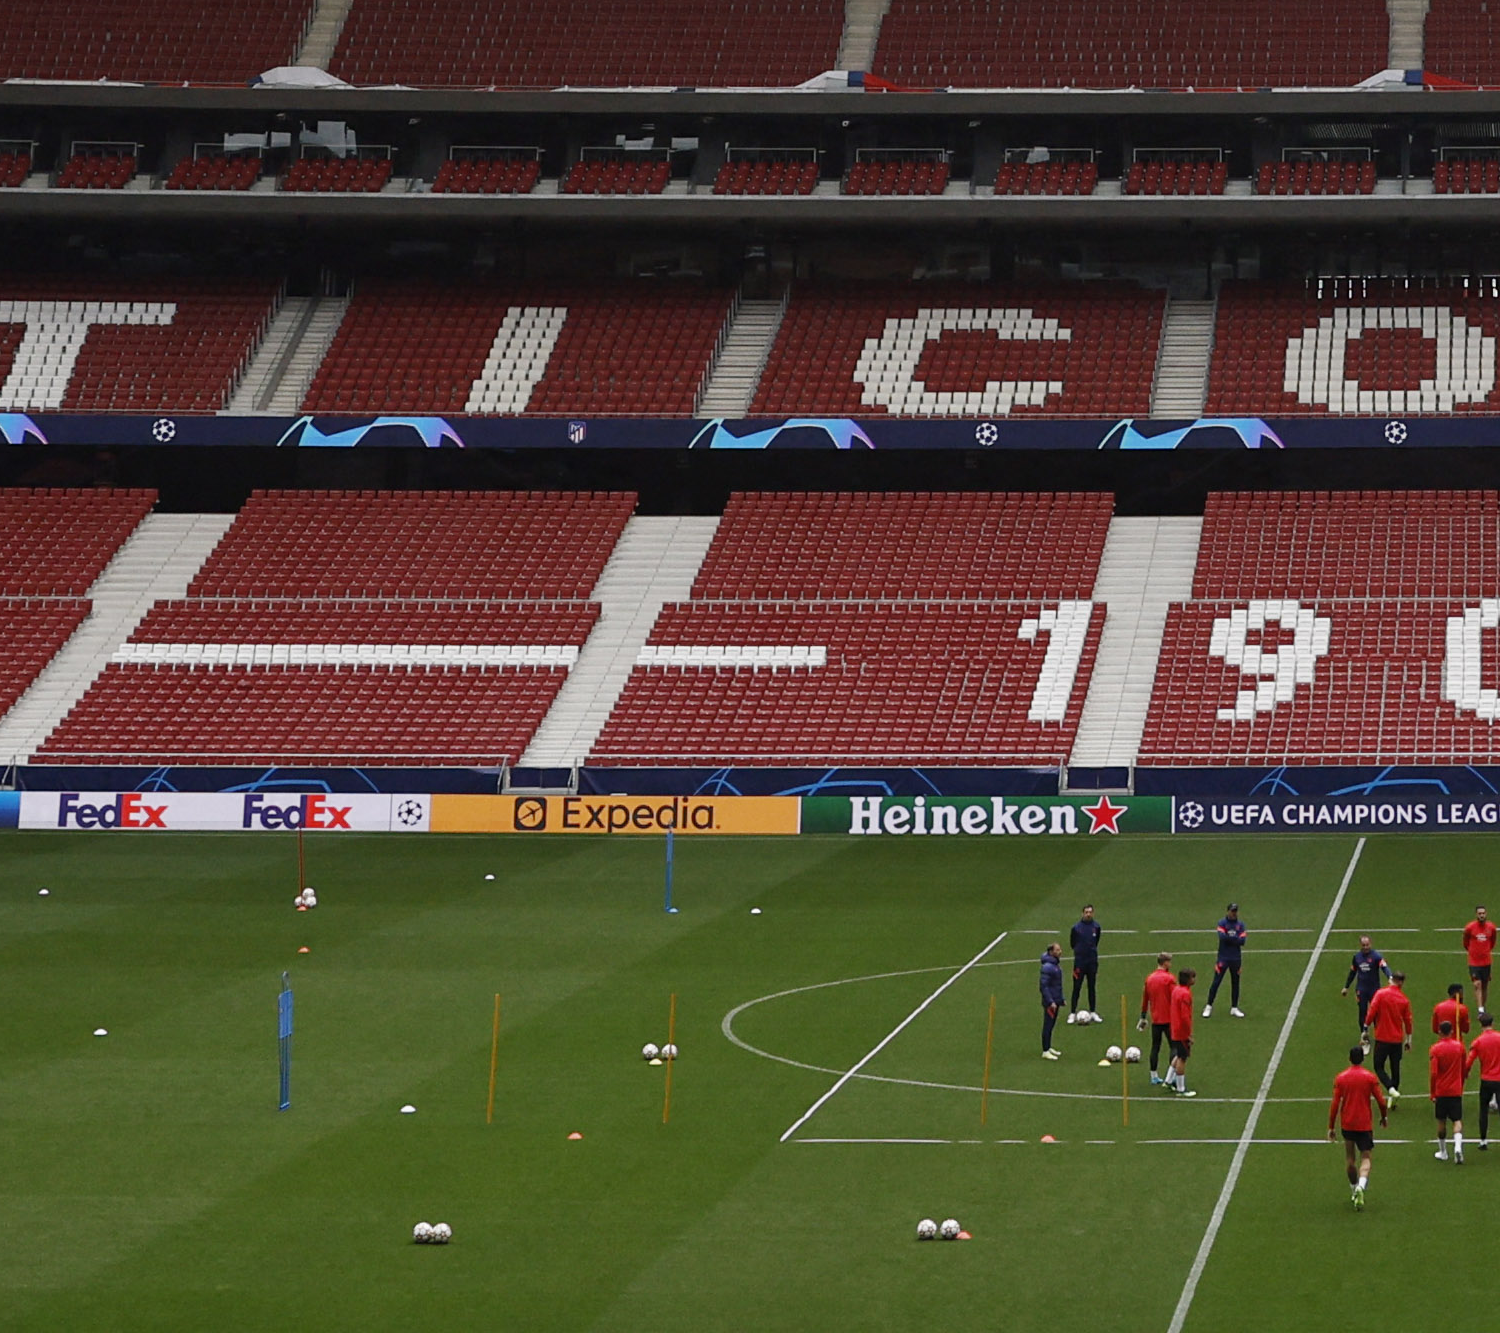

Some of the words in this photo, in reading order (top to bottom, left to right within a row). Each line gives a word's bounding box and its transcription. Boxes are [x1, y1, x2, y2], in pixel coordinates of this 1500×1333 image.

[58, 793, 167, 829] FedEx
[243, 794, 351, 830] FedEx
[848, 796, 1080, 836] Heineken
[1210, 803, 1276, 825] UEFA
[1282, 803, 1428, 825] CHAMPIONS
